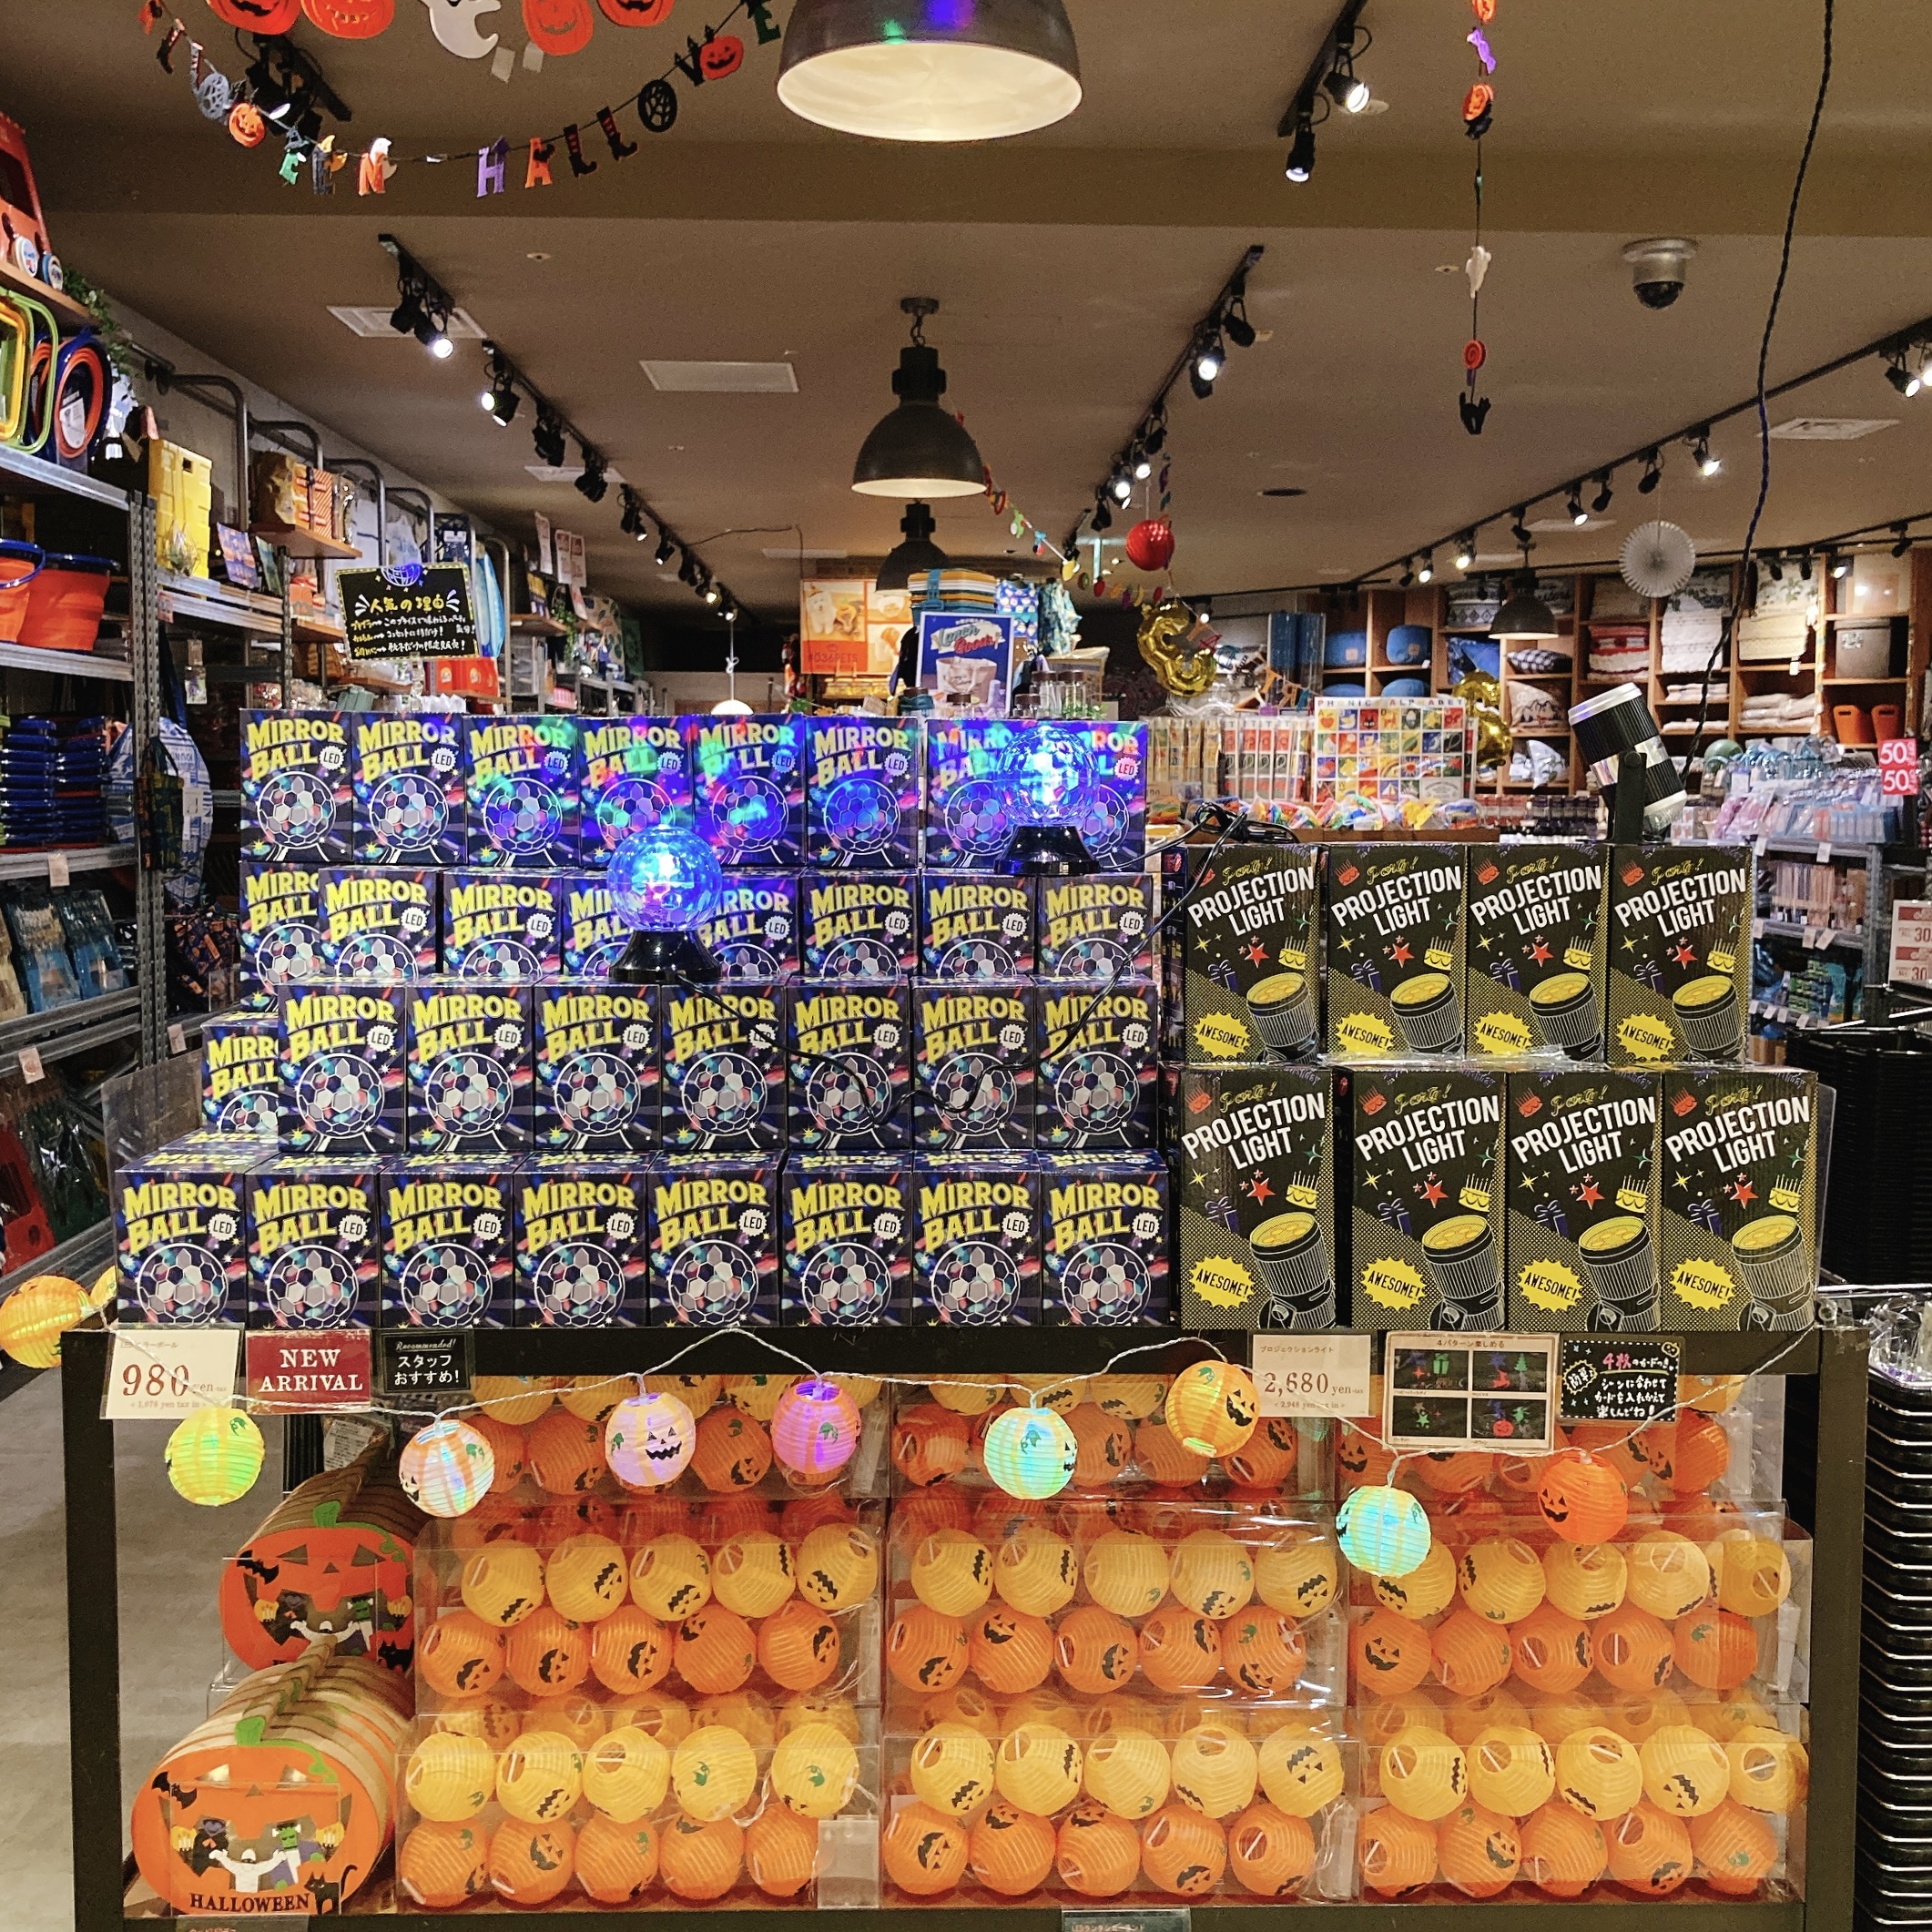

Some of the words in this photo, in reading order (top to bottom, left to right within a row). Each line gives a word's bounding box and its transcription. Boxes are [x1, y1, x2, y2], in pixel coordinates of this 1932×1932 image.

[370, 594, 444, 613] 人気の理由
[247, 717, 347, 753] MIRROR
[358, 719, 458, 755] MIRROR
[470, 721, 572, 758] MIRROR
[583, 723, 685, 760] MIRROR
[697, 723, 794, 761] MIRROR
[813, 725, 910, 759] MIRROR
[936, 724, 1013, 759] MIRRO
[250, 745, 319, 780] BALL
[324, 752, 340, 763] LED
[362, 747, 430, 783] BALL
[435, 754, 452, 766] LED
[473, 751, 544, 788] BALL
[587, 750, 656, 788] BALL
[704, 747, 771, 783] BALL
[817, 750, 883, 787] BALL
[249, 894, 318, 934] BALL
[325, 877, 430, 914] MIRROR
[451, 883, 555, 920] MIRROR
[810, 883, 912, 919] MIRROR
[928, 883, 1027, 919] MIRROR
[1045, 883, 1144, 920] MIRROR
[1187, 867, 1315, 928] PROJECTION
[1331, 866, 1461, 927] PROJECTION
[1469, 865, 1602, 926] PROJECTION
[1614, 868, 1746, 928] PROJECTION
[329, 904, 400, 943] BALL
[405, 913, 422, 926] LED
[453, 910, 525, 949] BALL
[531, 920, 547, 932] LED
[697, 913, 764, 949] BALL
[768, 922, 786, 934] LED
[814, 910, 882, 949] BALL
[889, 918, 906, 930] LED
[931, 910, 1000, 949] BALL
[1006, 918, 1022, 930] LED
[1050, 910, 1116, 949] BALL
[1123, 918, 1140, 930] LED
[1229, 898, 1285, 936] LIGHT
[1373, 897, 1430, 936] LIGHT
[1512, 897, 1570, 935] LIGHT
[1657, 899, 1714, 937] LIGHT
[285, 994, 397, 1034] MIRROR
[412, 994, 525, 1034] MIRROR
[543, 994, 654, 1034] MIRROR
[668, 994, 778, 1034] MIRROR
[794, 994, 902, 1034] MIRROR
[921, 994, 1028, 1034] MIRROR
[1044, 995, 1152, 1033] MIRROR
[208, 1035, 279, 1072] MIRR
[289, 1022, 364, 1064] BALL
[371, 1033, 390, 1046] LED
[416, 1022, 493, 1064] BALL
[499, 1032, 517, 1043] LED
[546, 1022, 622, 1064] BALL
[627, 1032, 646, 1044] LED
[674, 1022, 748, 1063] BALL
[798, 1022, 872, 1063] BALL
[879, 1031, 896, 1044] LED
[925, 1022, 997, 1063] BALL
[1004, 1031, 1022, 1044] LED
[1126, 1030, 1144, 1042] LED
[1199, 1024, 1246, 1048] AWESOME!
[1341, 1023, 1389, 1050] AWESOME!
[1480, 1023, 1527, 1050] AWESOME!
[1623, 1024, 1670, 1051] AWESOME!
[210, 1060, 279, 1101] BALL
[1181, 1093, 1325, 1160] PROJECTION
[1355, 1095, 1500, 1161] PROJECTION
[1511, 1096, 1656, 1163] PROJECTION
[1665, 1096, 1809, 1162] PROJECTION
[1228, 1126, 1292, 1170] LIGHT
[1402, 1129, 1466, 1172] LIGHT
[1558, 1132, 1622, 1174] LIGHT
[1712, 1131, 1775, 1173] LIGHT
[123, 1181, 240, 1224] MIRROR
[254, 1181, 371, 1224] MIRROR
[388, 1181, 506, 1224] MIRROR
[521, 1181, 638, 1224] MIRROR
[655, 1178, 768, 1221] MIRROR
[790, 1180, 906, 1224] MIRROR
[919, 1180, 1032, 1224] MIRROR
[1049, 1180, 1163, 1224] MIRROR
[128, 1207, 208, 1254] BALL
[213, 1220, 232, 1235] LED
[259, 1209, 337, 1256] BALL
[343, 1221, 363, 1235] LED
[393, 1207, 473, 1255] BALL
[479, 1221, 497, 1235] LED
[526, 1207, 606, 1254] BALL
[611, 1219, 631, 1234] LED
[659, 1205, 737, 1254] BALL
[744, 1216, 763, 1231] LED
[795, 1207, 871, 1254] BALL
[879, 1219, 897, 1234] LED
[924, 1207, 1002, 1254] BALL
[1007, 1219, 1025, 1234] LED
[1054, 1207, 1131, 1256] BALL
[1136, 1219, 1155, 1234] LED
[1195, 1268, 1247, 1298] AWESOME!
[1368, 1270, 1419, 1300] AWESOME!
[1524, 1272, 1576, 1303] AWESOME!
[1677, 1271, 1729, 1300] AWESOME!
[280, 1349, 341, 1368] NEW
[396, 1339, 456, 1351] Recommended!
[398, 1355, 452, 1368] スタッフ
[1437, 1339, 1505, 1348] 4パターン楽しめる
[123, 1364, 188, 1397] 980
[259, 1374, 362, 1393] ARRIVAL
[394, 1370, 460, 1385] おすすめ!
[1265, 1372, 1328, 1397] 2,680
[1332, 1386, 1351, 1396] yen
[1602, 1375, 1667, 1390] シーンに合わせて
[1594, 1391, 1665, 1404] カードを入れかえて
[189, 1893, 310, 1912] HALLOWEEN
